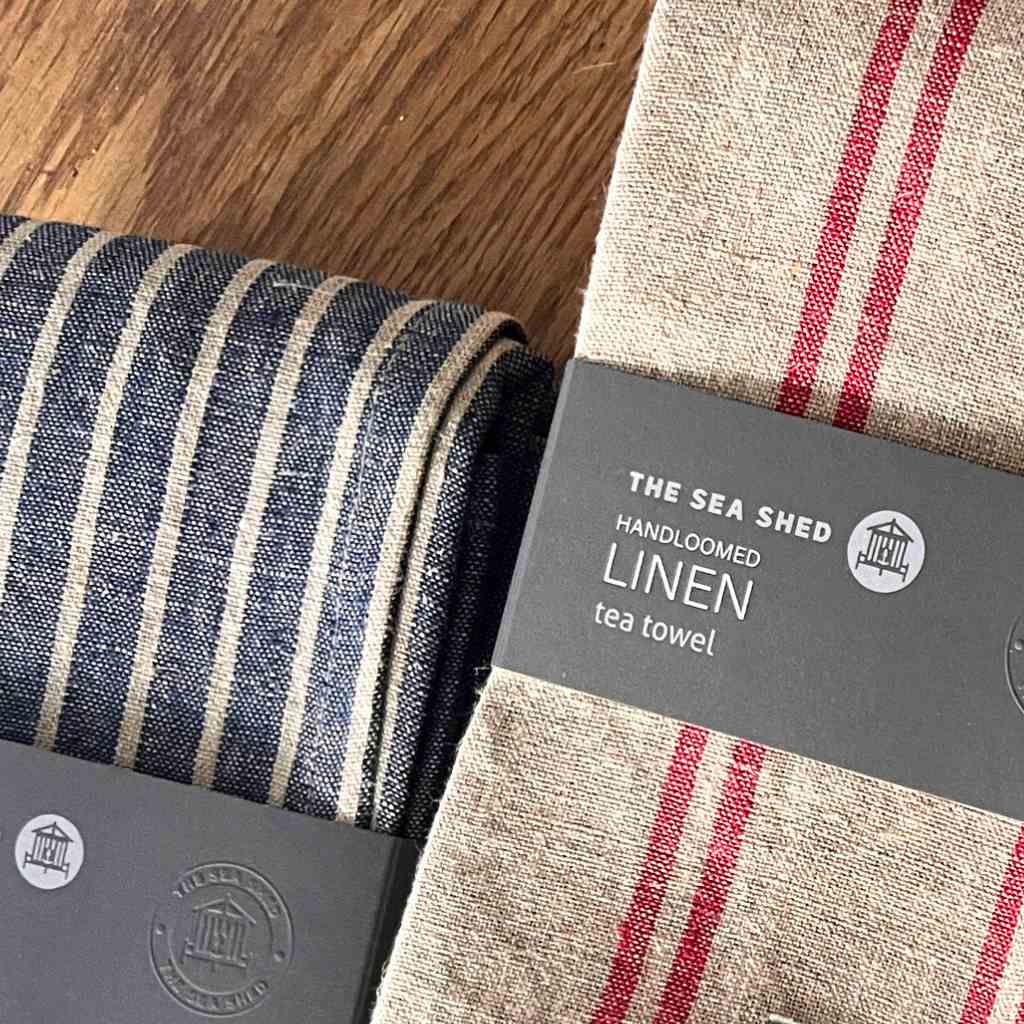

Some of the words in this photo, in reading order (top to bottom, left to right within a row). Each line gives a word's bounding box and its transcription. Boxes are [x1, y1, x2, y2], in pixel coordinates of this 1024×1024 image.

[629, 470, 682, 504] THE
[688, 487, 744, 522] SEA
[755, 505, 833, 543] SHED
[615, 513, 762, 568] HANDLOOMED
[602, 541, 755, 621] LINEN
[594, 600, 636, 633] tea
[641, 613, 717, 657] towel
